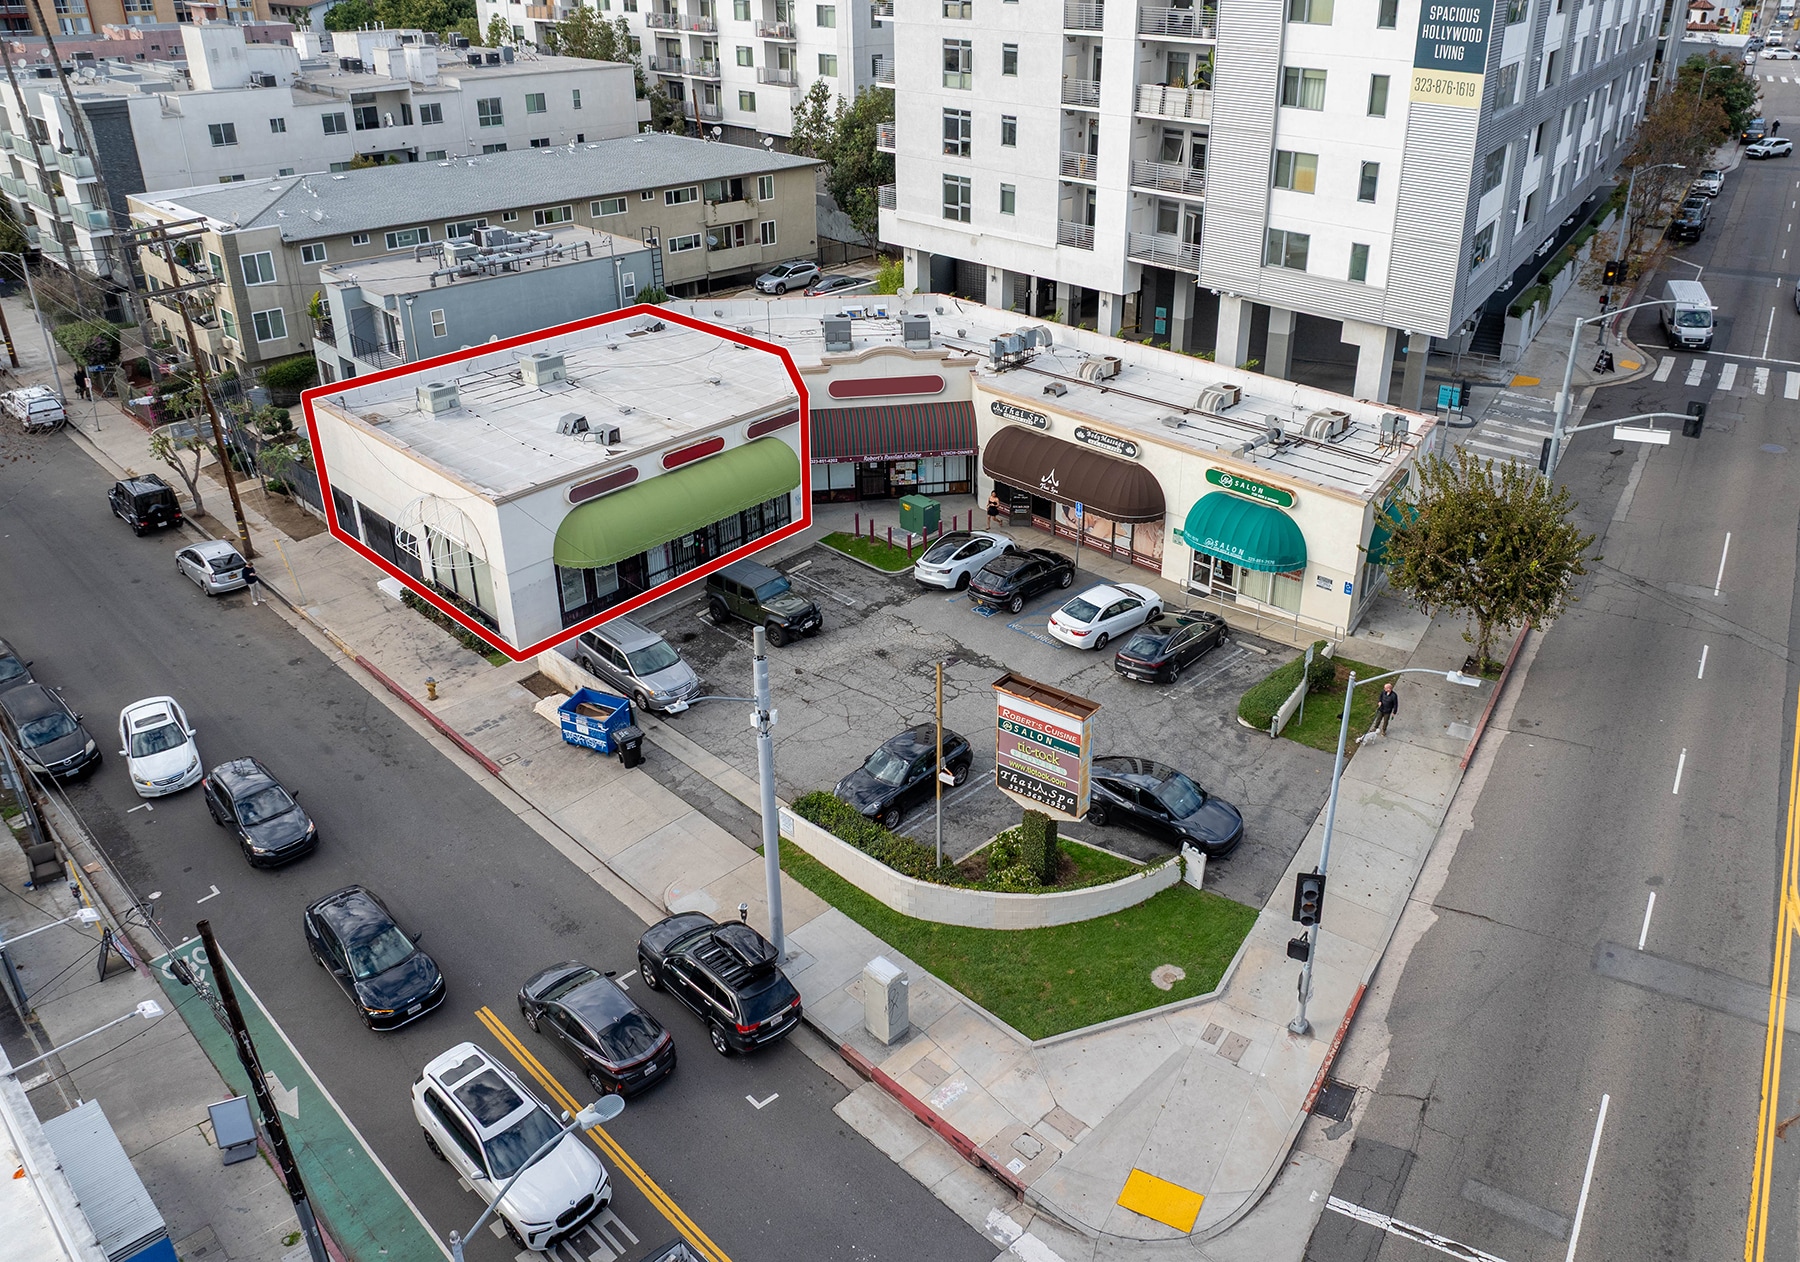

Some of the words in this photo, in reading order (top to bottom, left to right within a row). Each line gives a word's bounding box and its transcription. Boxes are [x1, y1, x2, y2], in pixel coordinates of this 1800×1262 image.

[1429, 5, 1481, 24] SPACIOUS
[1421, 24, 1483, 43] HOLLYWOOD
[1434, 44, 1465, 61] LIVING
[1002, 404, 1025, 418] Thai
[1028, 413, 1045, 425] Spa
[1234, 480, 1264, 494] SALON
[1214, 540, 1245, 556] SALON
[1002, 708, 1042, 730] ROBERT'S
[1044, 724, 1078, 743] CUISINE
[1013, 725, 1053, 745] SALON
[1017, 741, 1060, 766] tic-tock
[1000, 770, 1033, 790] Thai
[1049, 790, 1075, 805] Spa
[1008, 783, 1066, 811] 323.369.1929
